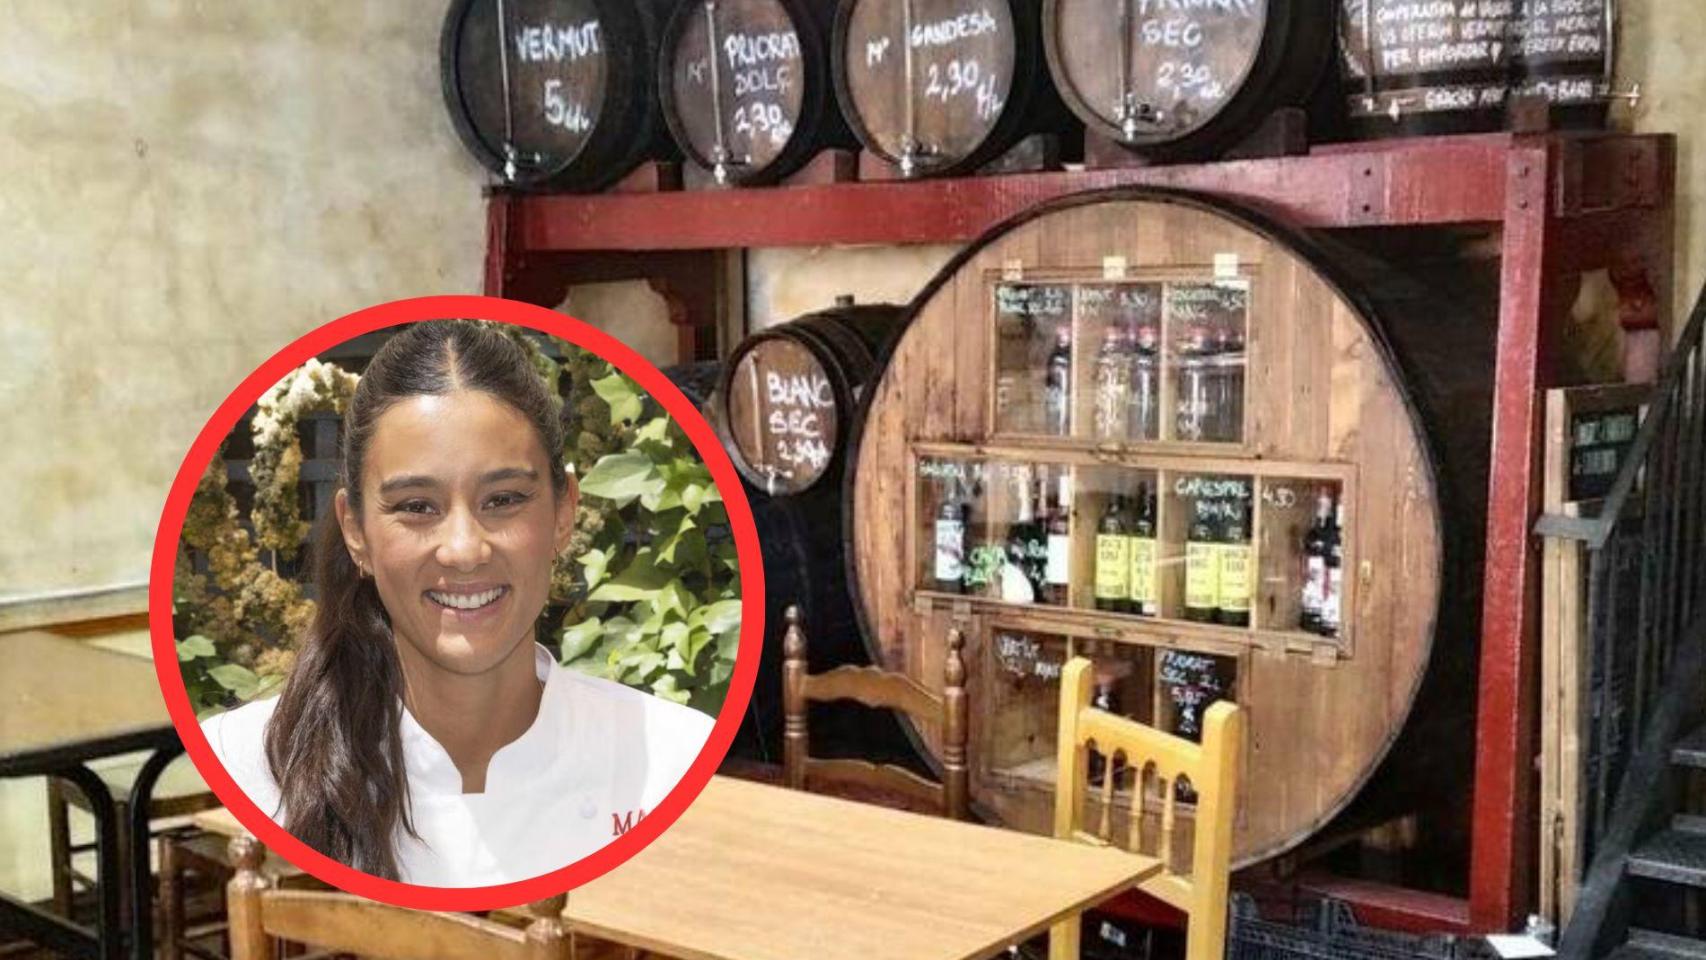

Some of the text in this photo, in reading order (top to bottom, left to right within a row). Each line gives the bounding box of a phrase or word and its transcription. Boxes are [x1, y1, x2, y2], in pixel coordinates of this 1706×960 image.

[515, 19, 600, 61] VERMUT
[1141, 18, 1202, 47] SEC
[766, 370, 835, 408] BLANC
[768, 410, 821, 438] SEC
